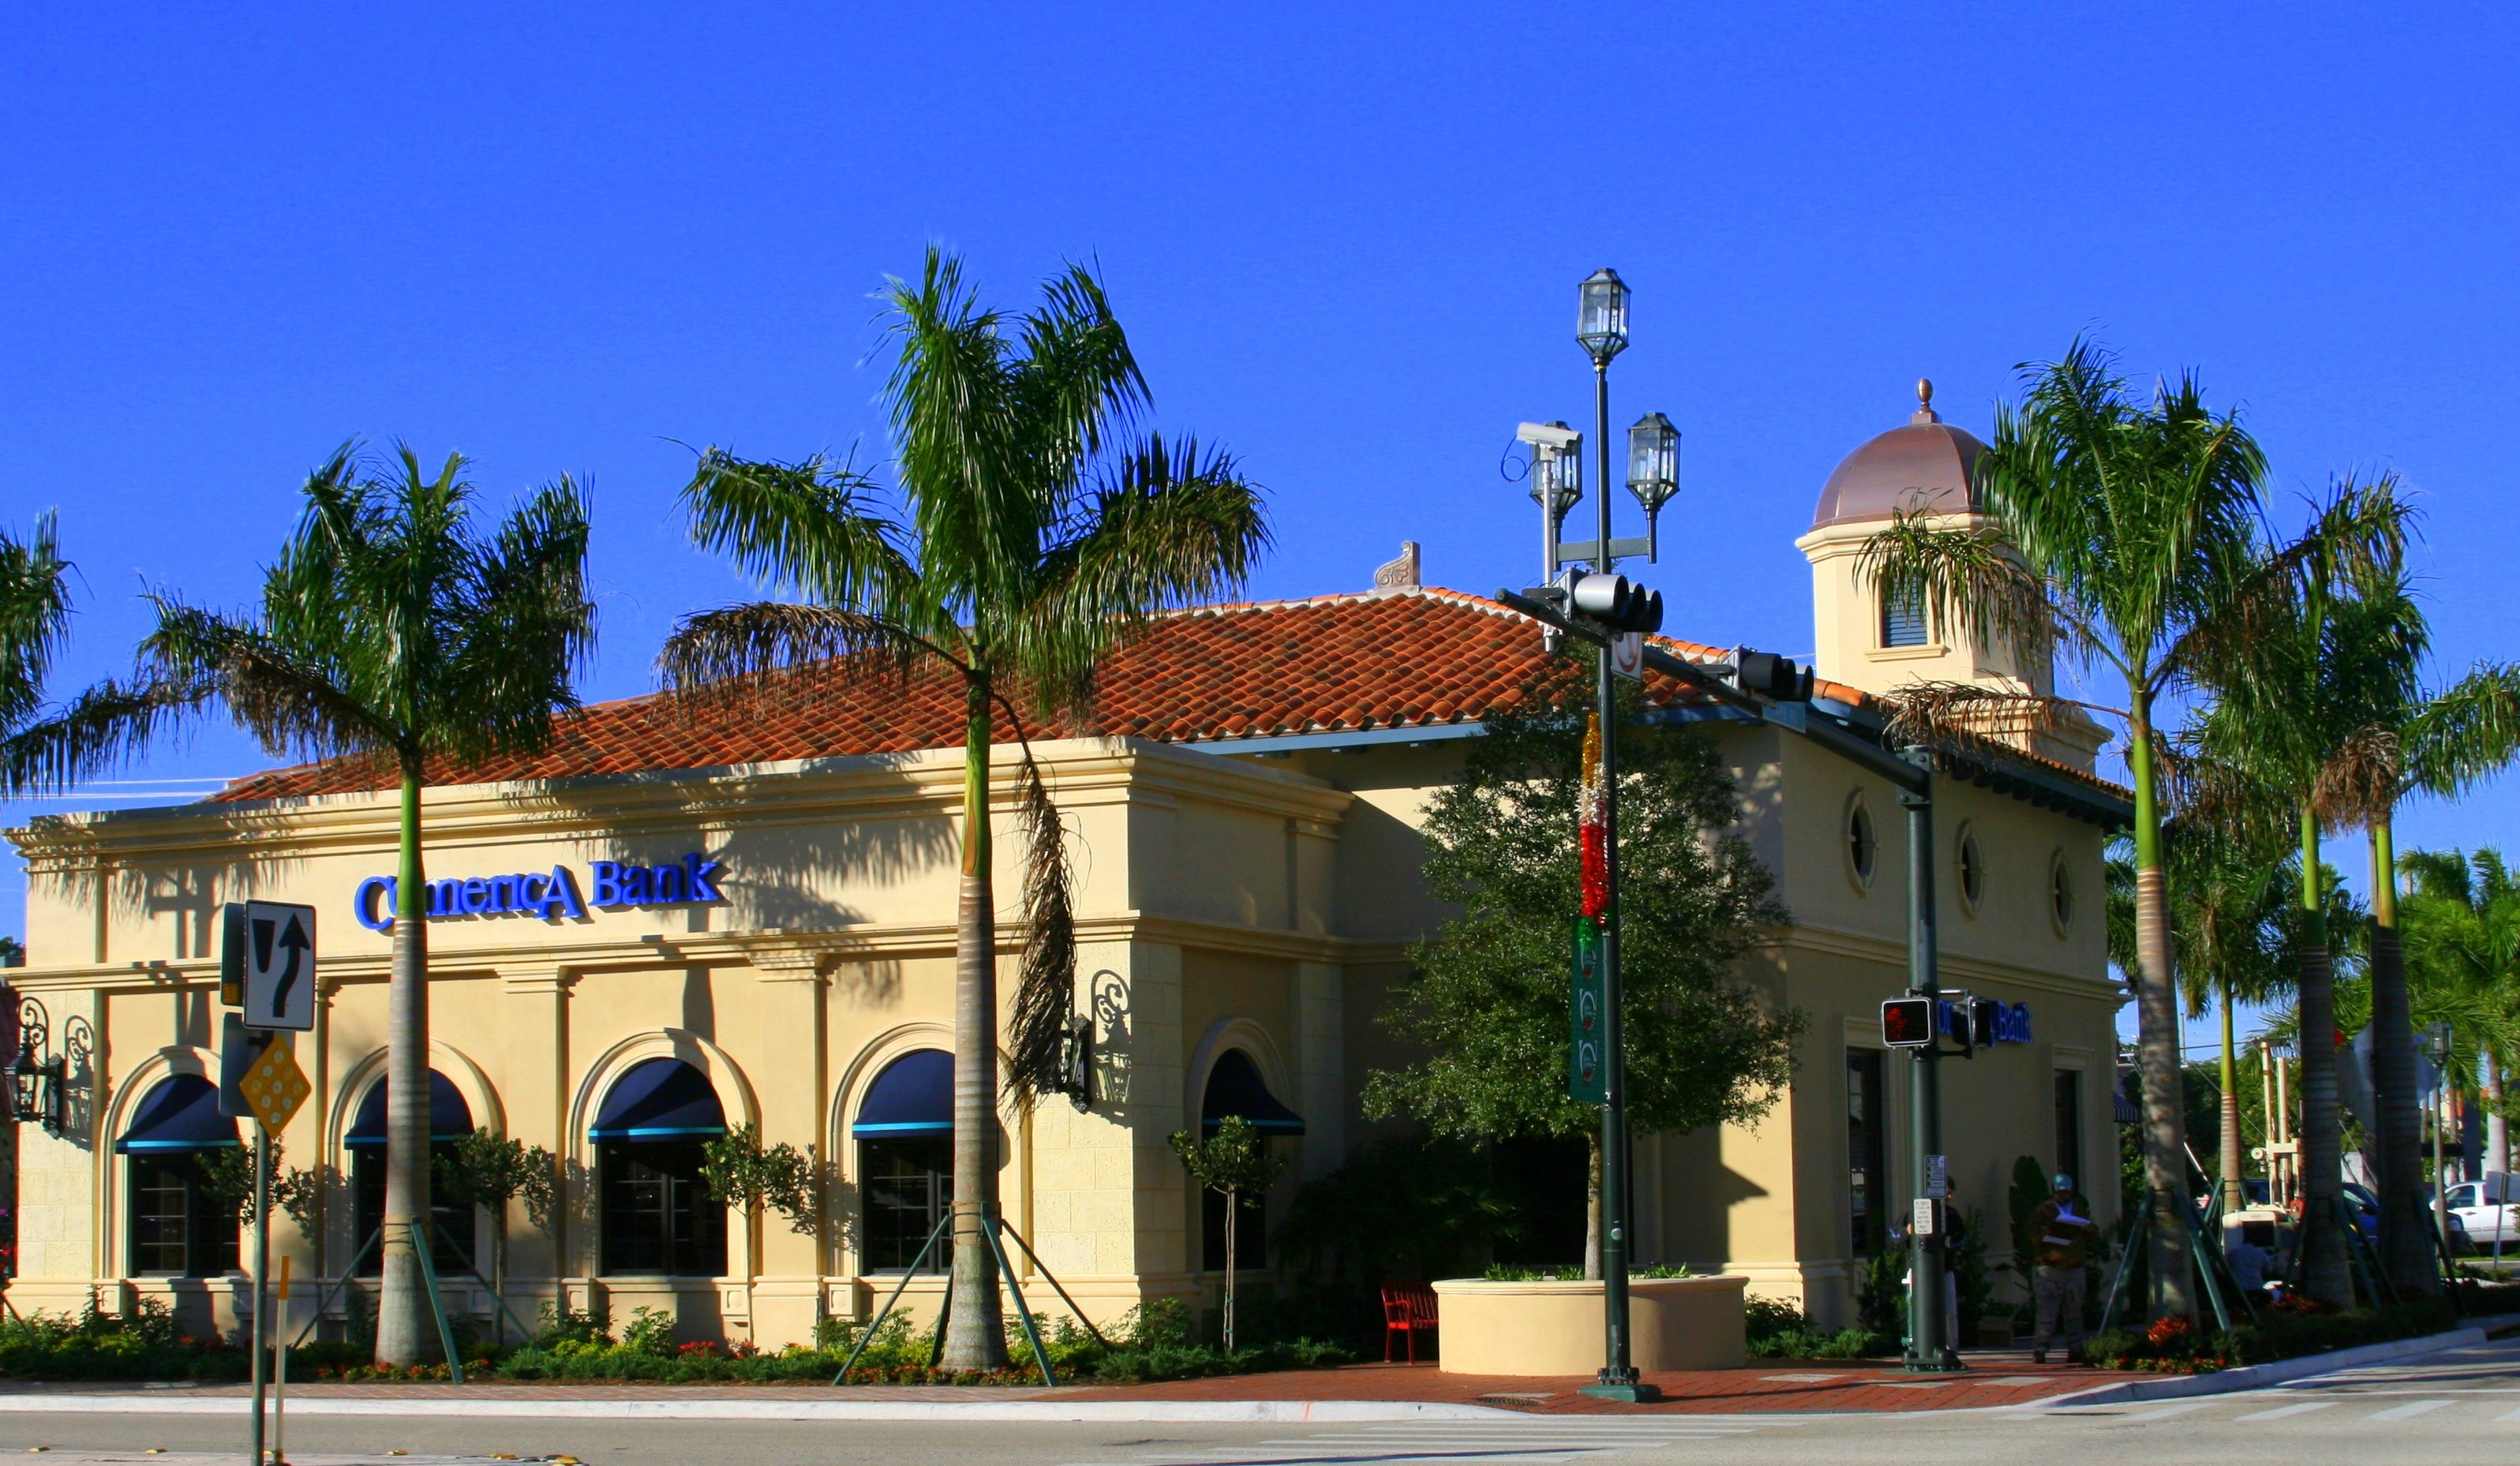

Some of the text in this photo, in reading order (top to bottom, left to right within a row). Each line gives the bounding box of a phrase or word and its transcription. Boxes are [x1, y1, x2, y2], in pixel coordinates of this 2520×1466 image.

[354, 852, 719, 929] CmericA Bank
[1995, 1001, 2034, 1043] Bank
